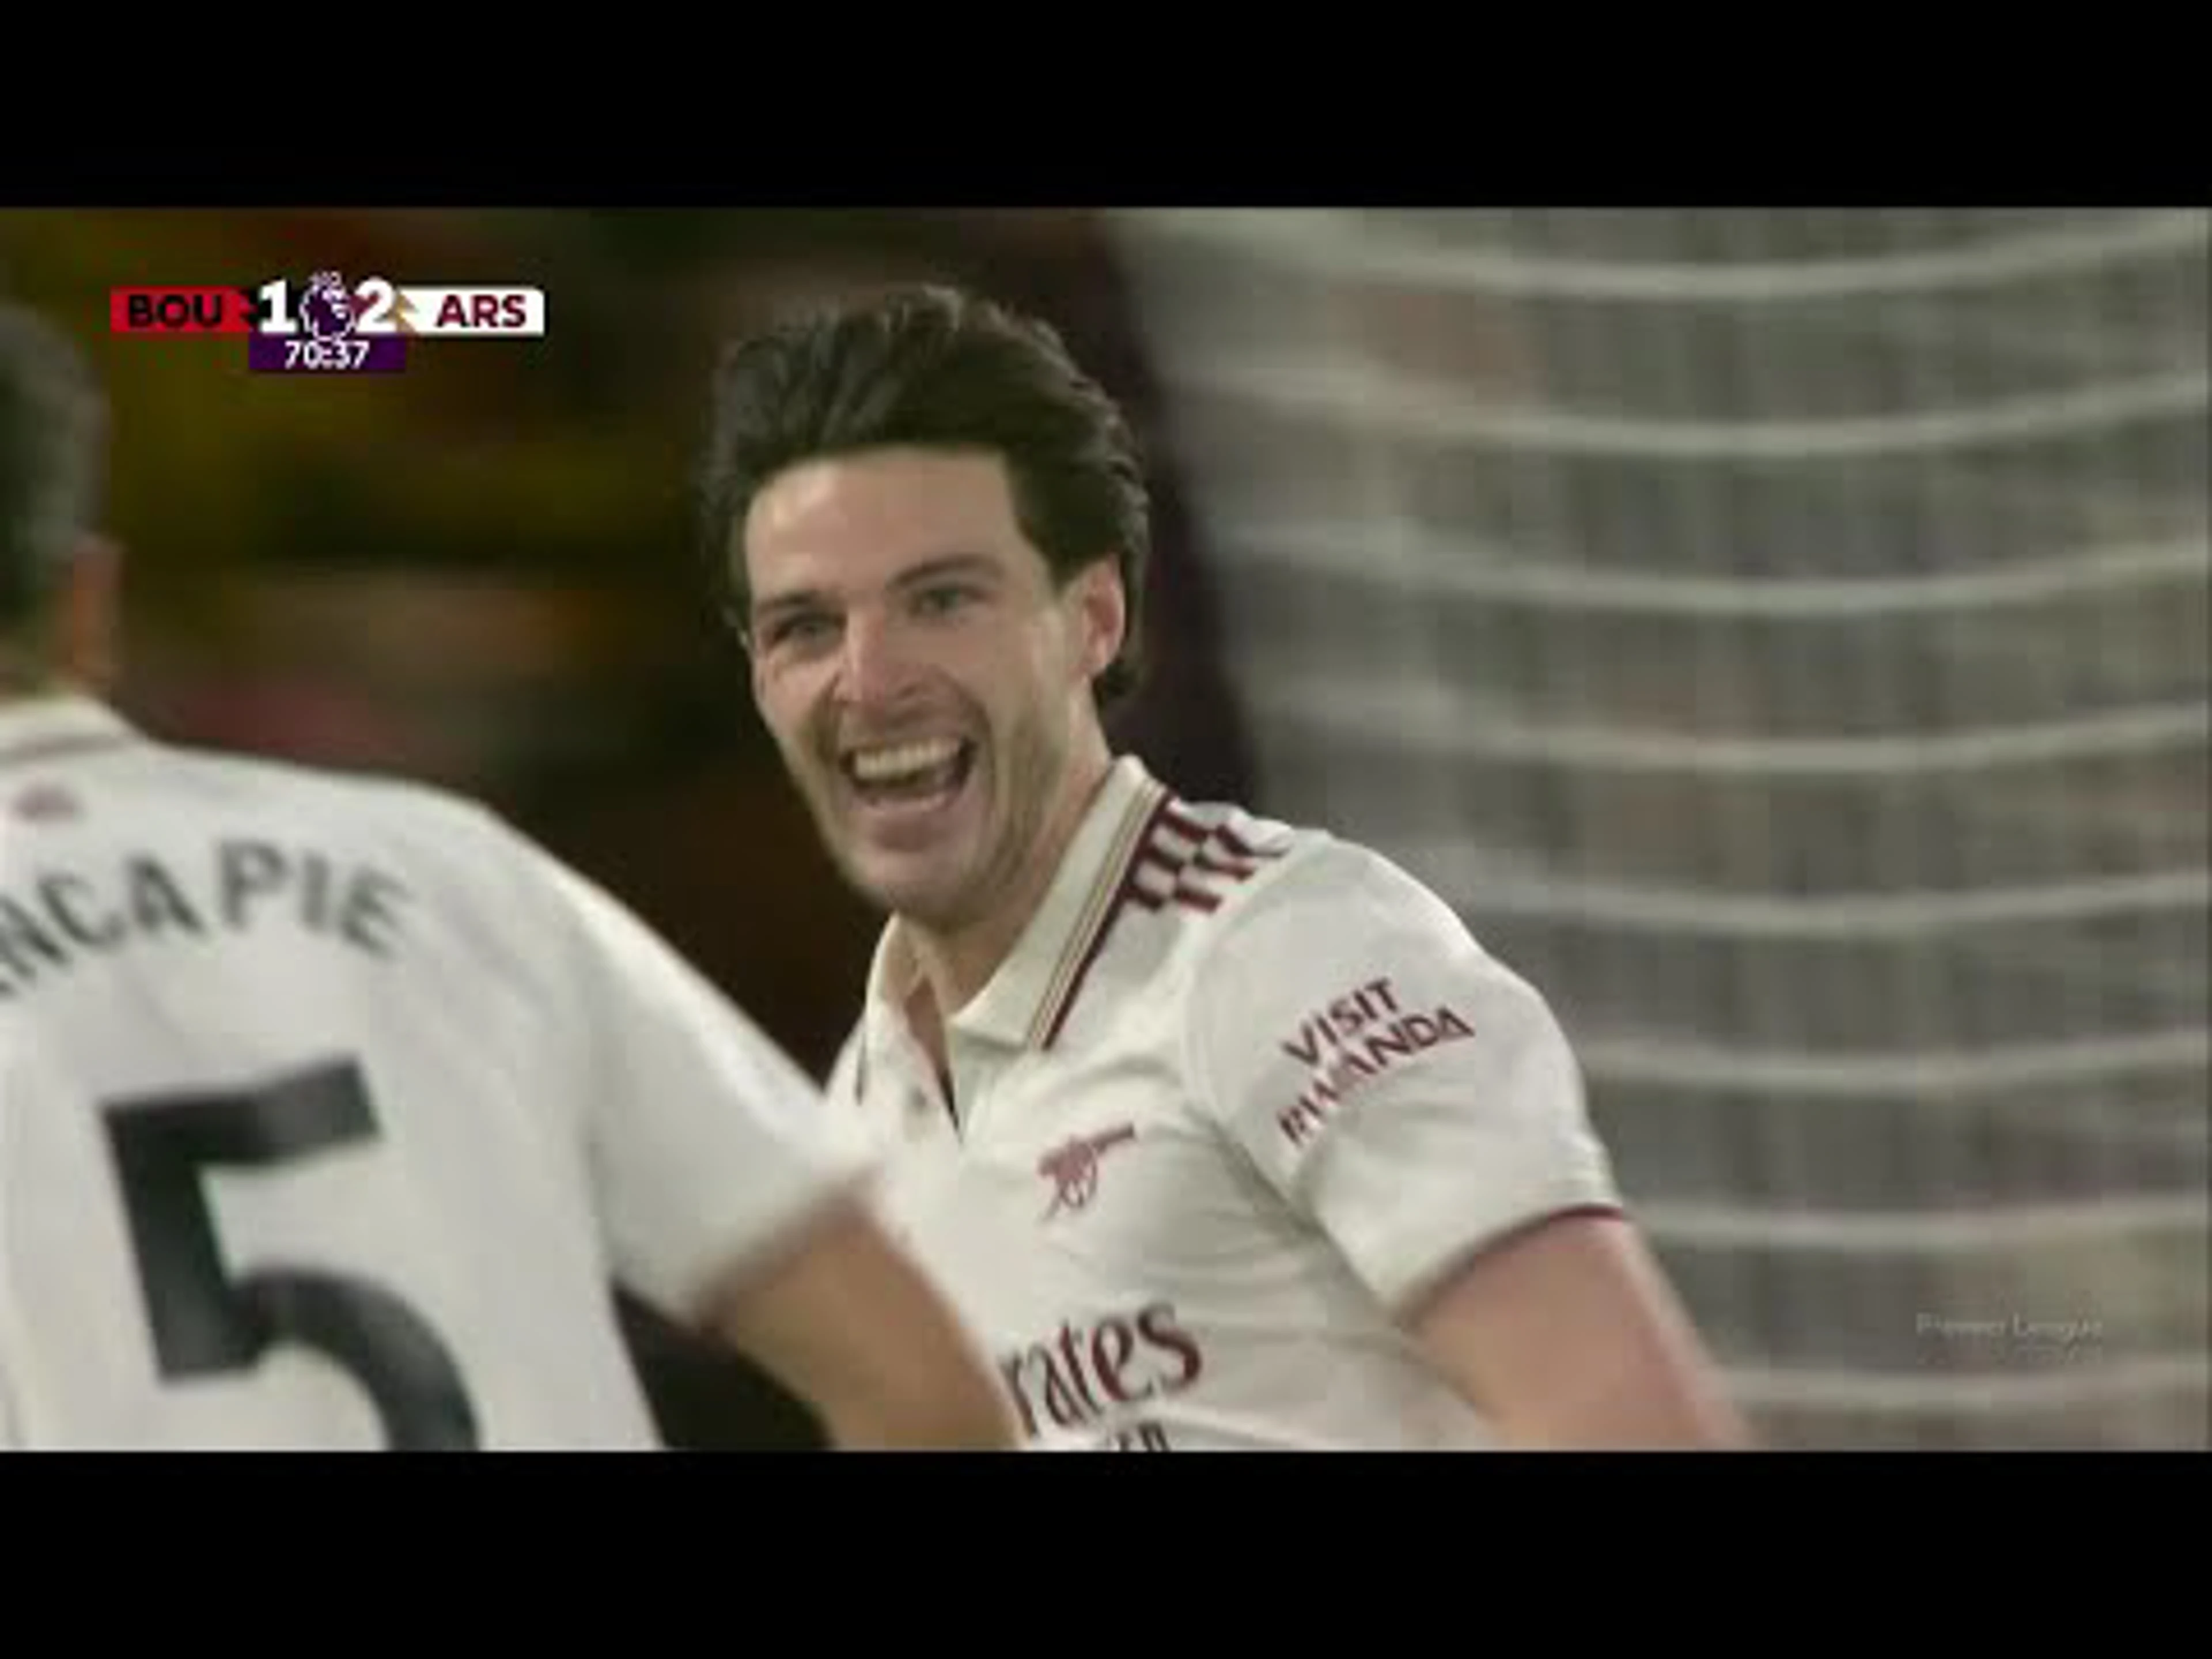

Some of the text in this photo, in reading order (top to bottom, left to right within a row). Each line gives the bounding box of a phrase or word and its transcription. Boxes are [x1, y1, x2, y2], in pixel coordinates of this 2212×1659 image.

[0, 840, 408, 997] NCAPIE
[1277, 1005, 1475, 1146] RWANDA
[1281, 978, 1397, 1066] VISIT
[99, 1052, 481, 1450] 5
[999, 1302, 1202, 1439] rates
